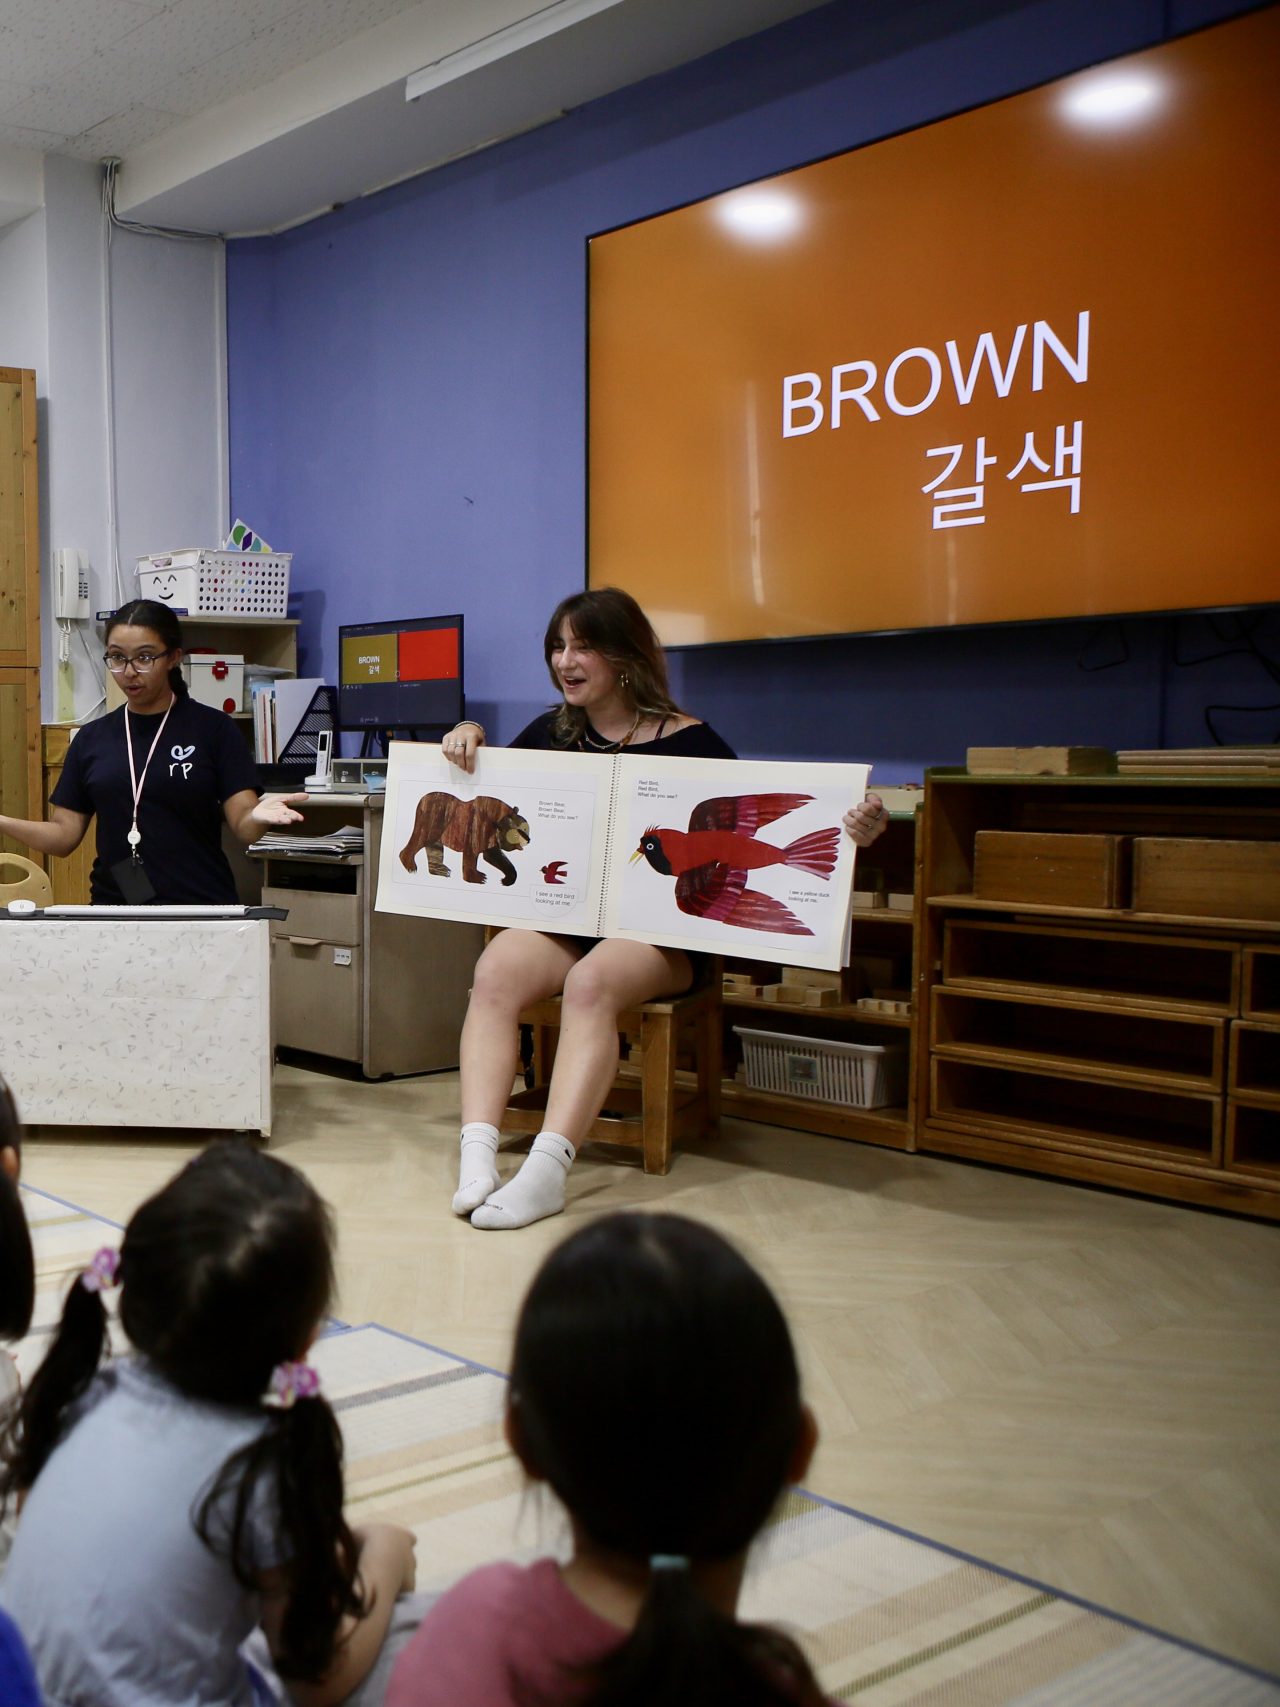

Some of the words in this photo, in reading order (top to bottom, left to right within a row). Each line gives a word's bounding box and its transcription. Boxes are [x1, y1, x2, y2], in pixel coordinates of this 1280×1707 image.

[782, 310, 1090, 438] BROWN
[921, 420, 1083, 530] 갈색
[358, 656, 380, 664] BROWN
[536, 898, 554, 906] looking
